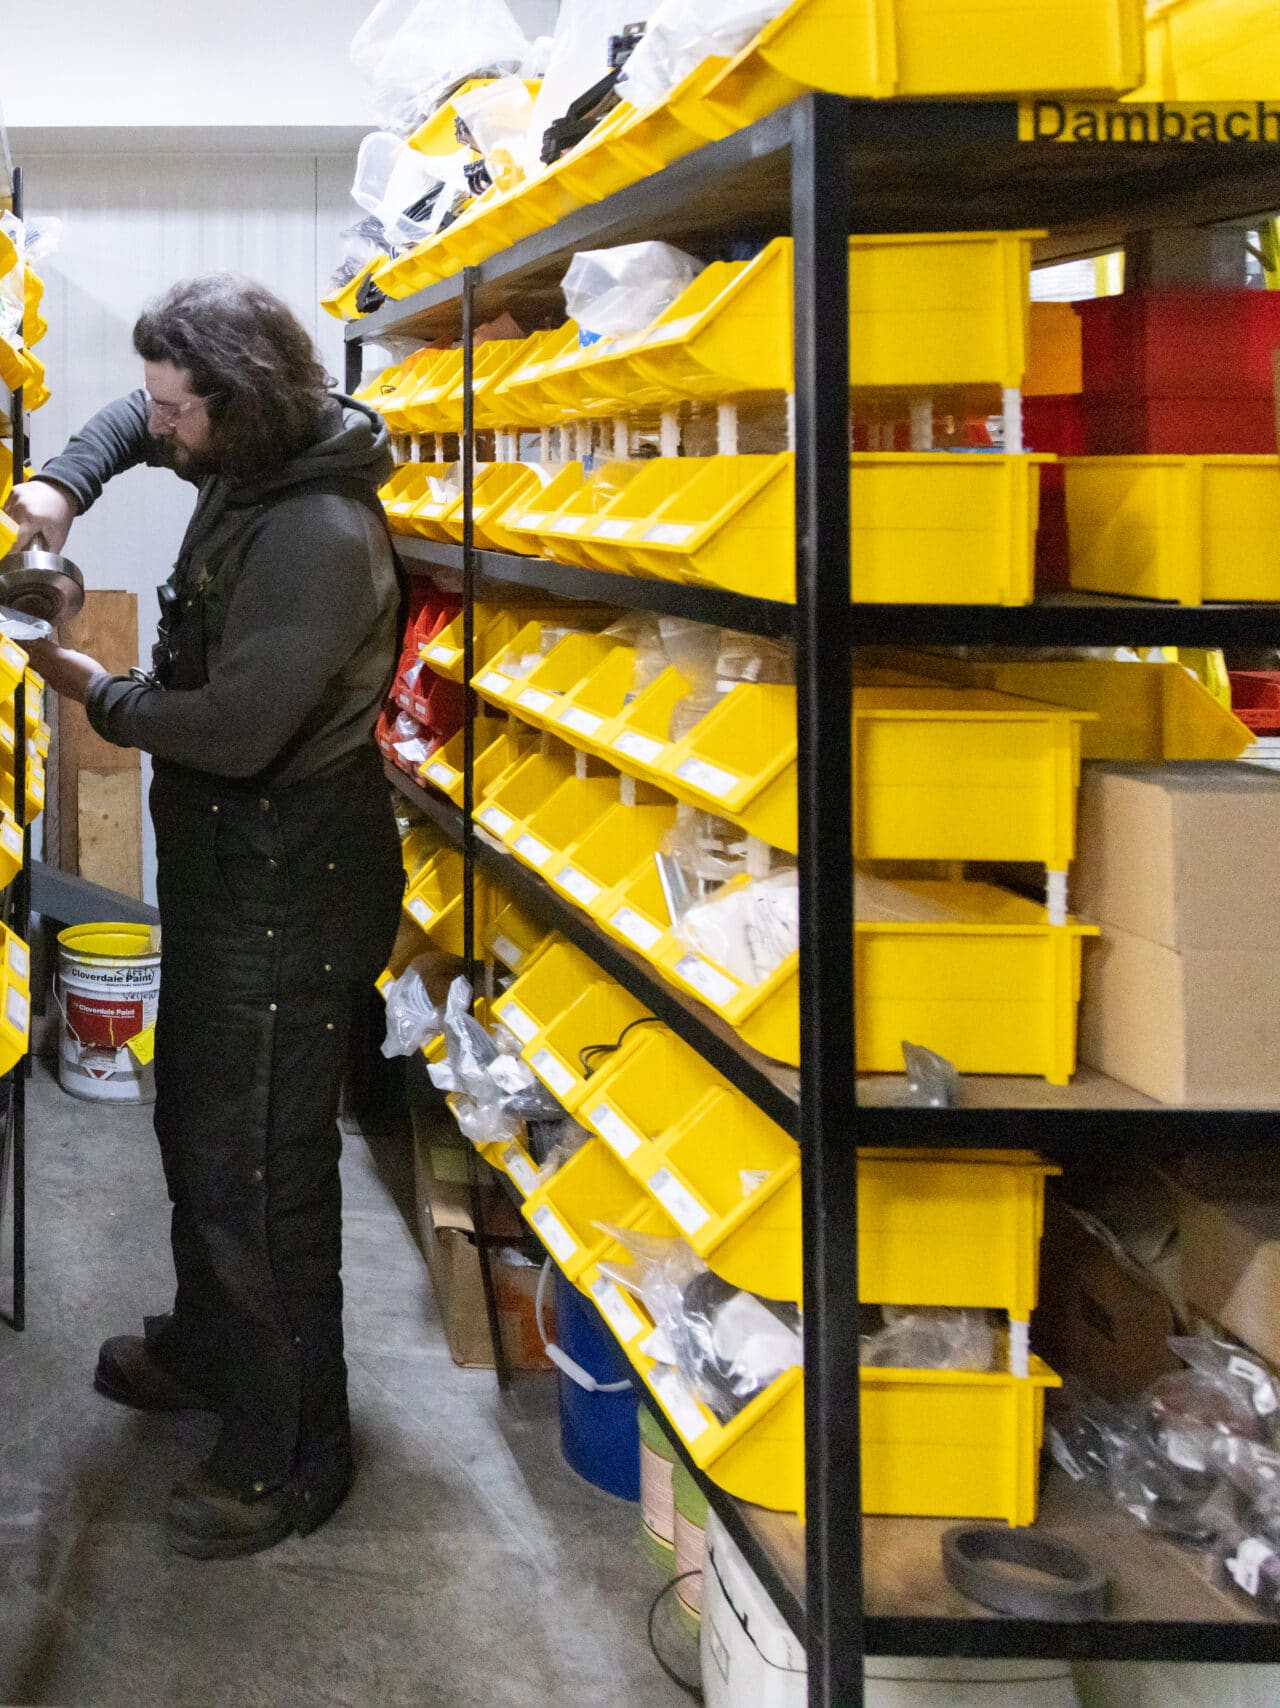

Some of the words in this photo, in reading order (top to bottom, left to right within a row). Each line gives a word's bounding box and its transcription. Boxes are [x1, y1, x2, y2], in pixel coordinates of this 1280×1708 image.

[1033, 100, 1280, 142] Dambach
[72, 966, 124, 983] Cloverdale
[126, 974, 151, 983] Paint
[79, 1004, 115, 1016] Cloverdale
[116, 1008, 136, 1016] Paint
